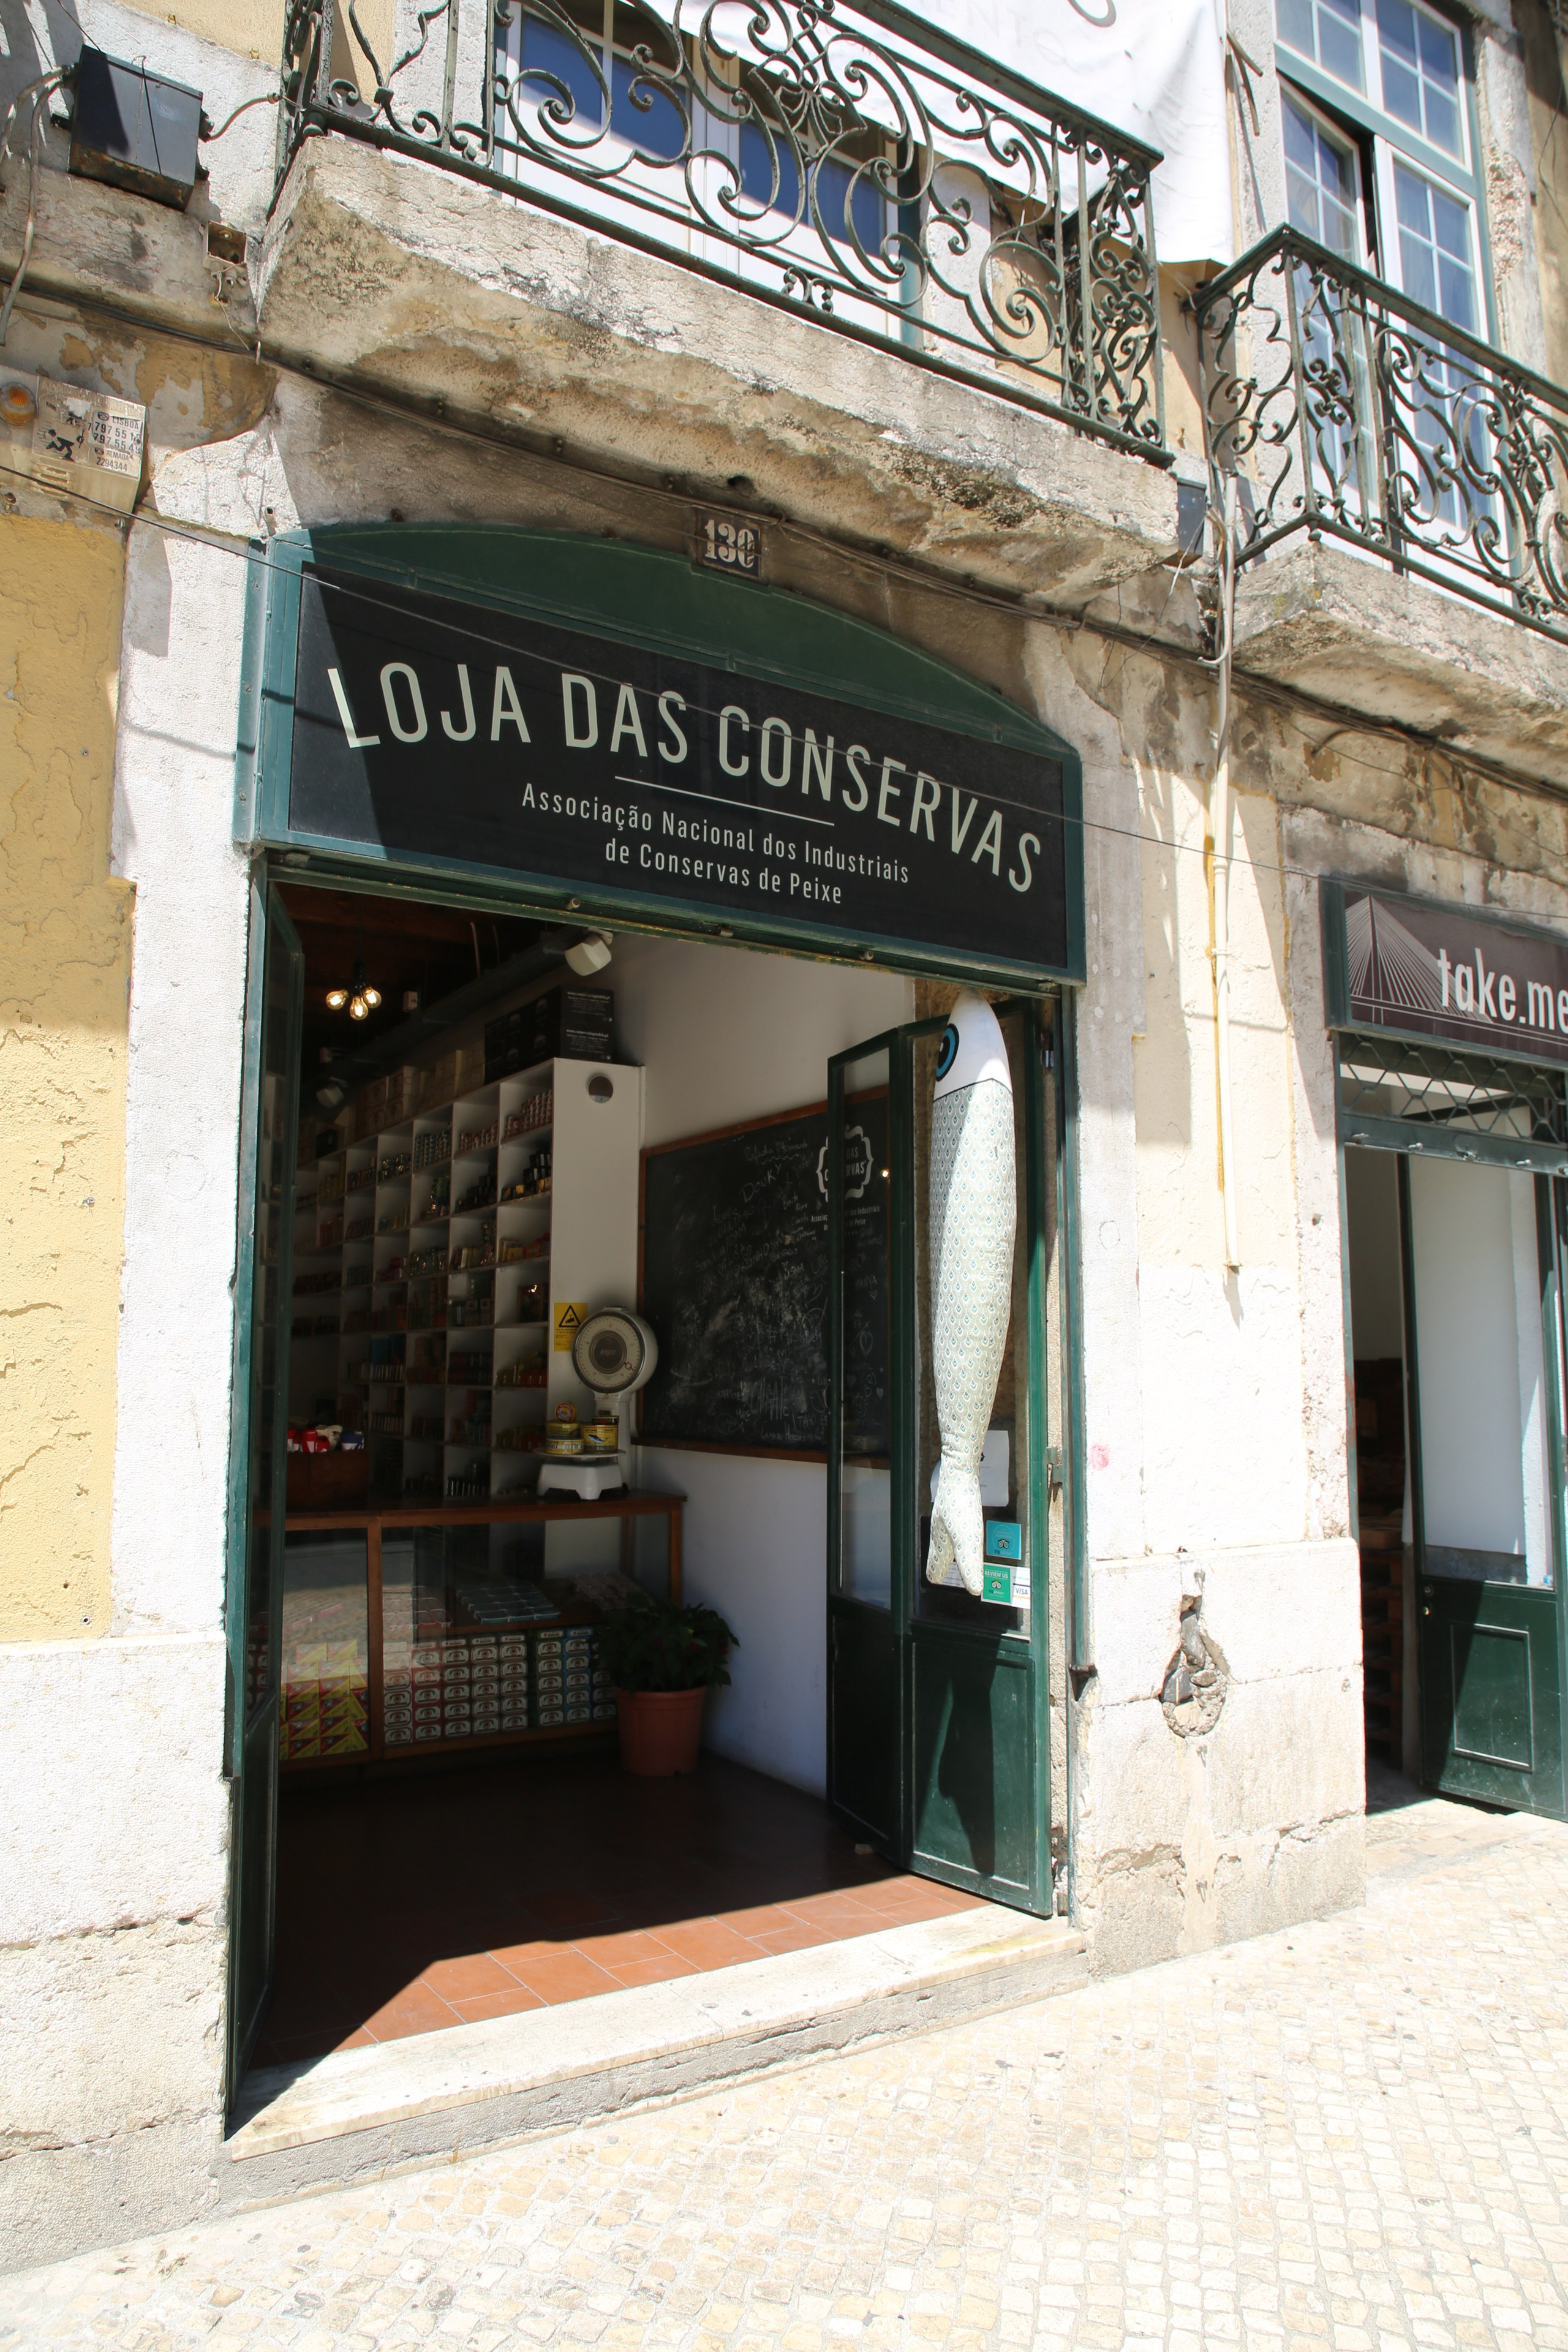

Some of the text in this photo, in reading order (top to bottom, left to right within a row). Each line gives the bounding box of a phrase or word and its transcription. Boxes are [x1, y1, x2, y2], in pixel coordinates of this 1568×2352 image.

[95, 421, 112, 435] 797
[115, 428, 127, 439] 55
[112, 416, 138, 430] LISBOA
[94, 432, 111, 444] 797
[115, 439, 126, 451] 55
[96, 456, 128, 472] 2294344
[704, 519, 755, 568] 130
[327, 662, 1041, 893] LOJA DAS CONSERVAS
[522, 783, 909, 884] Associação Nacional dos Industriais
[605, 837, 842, 904] de Conservas de Peixe
[846, 1147, 858, 1159] DAS
[858, 1204, 880, 1215] Industriais
[854, 1217, 865, 1226] Peixe
